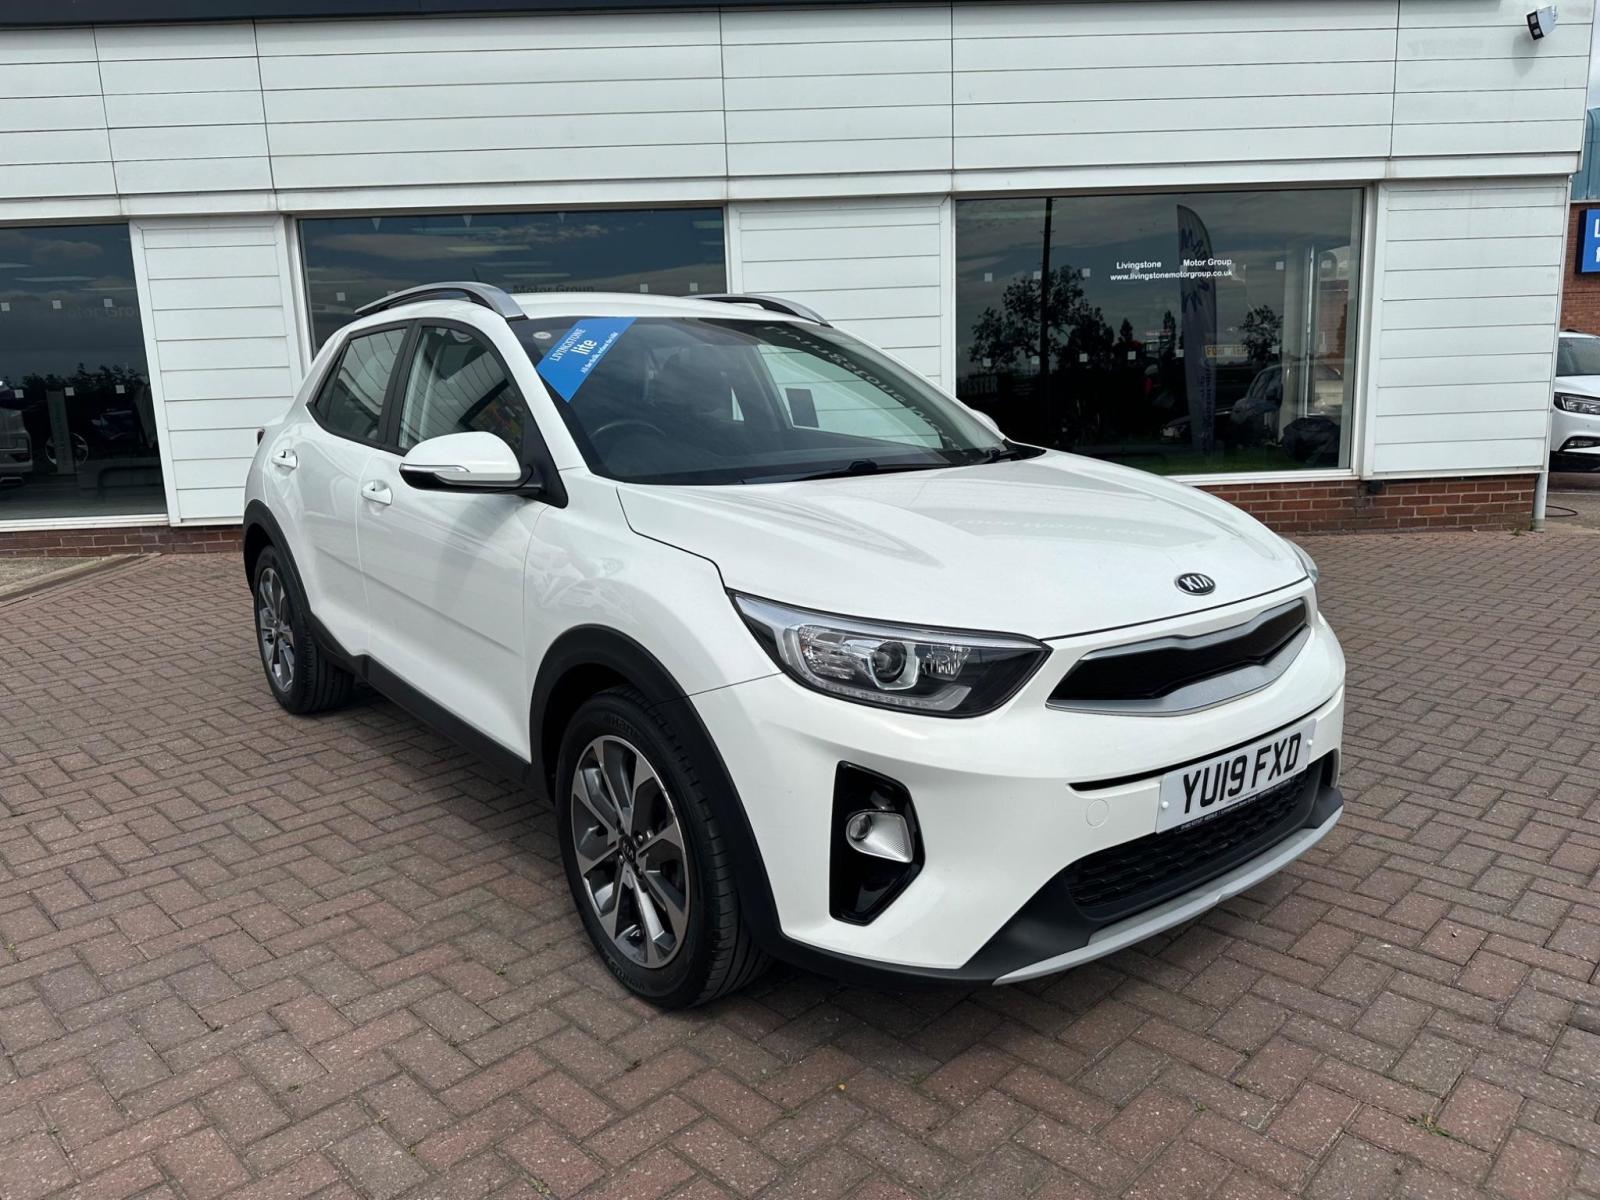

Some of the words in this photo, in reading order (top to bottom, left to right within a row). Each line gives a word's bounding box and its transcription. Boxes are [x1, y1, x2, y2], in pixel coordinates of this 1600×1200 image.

[1110, 269, 1233, 281] www.livingstonemotorgroup.co.uk
[1116, 260, 1162, 270] Livingstone
[1183, 259, 1206, 267] Motor
[1208, 258, 1232, 268] Group
[549, 327, 586, 362] LIVINGSTONE
[1183, 754, 1248, 814] YU19
[1251, 732, 1302, 788] FXD
